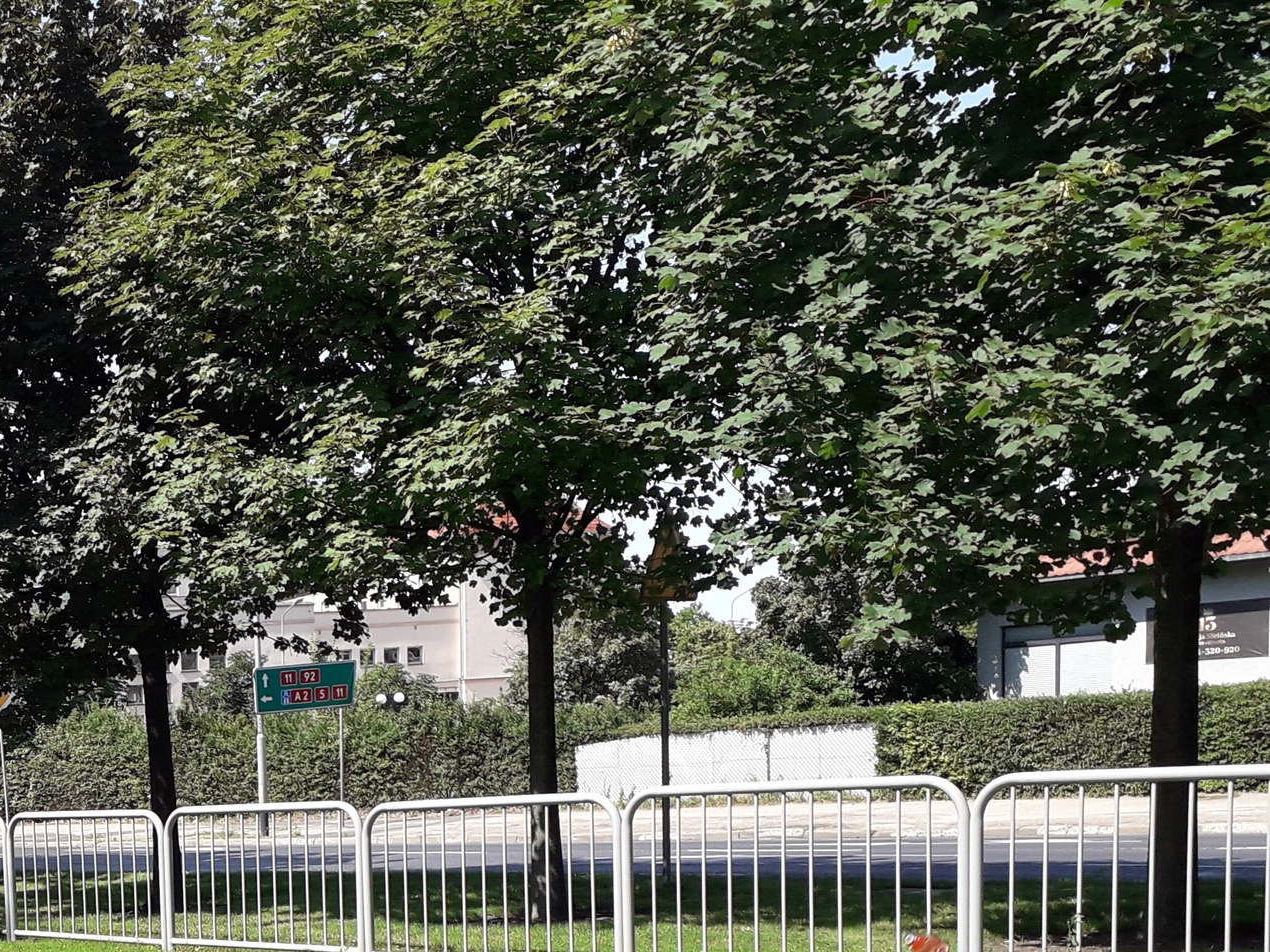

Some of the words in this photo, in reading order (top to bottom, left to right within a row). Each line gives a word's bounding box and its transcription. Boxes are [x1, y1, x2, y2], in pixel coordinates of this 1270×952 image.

[284, 673, 293, 684] 11
[303, 671, 316, 682] 92
[294, 690, 309, 702] A2
[319, 689, 325, 699] 5
[336, 687, 344, 698] 11
